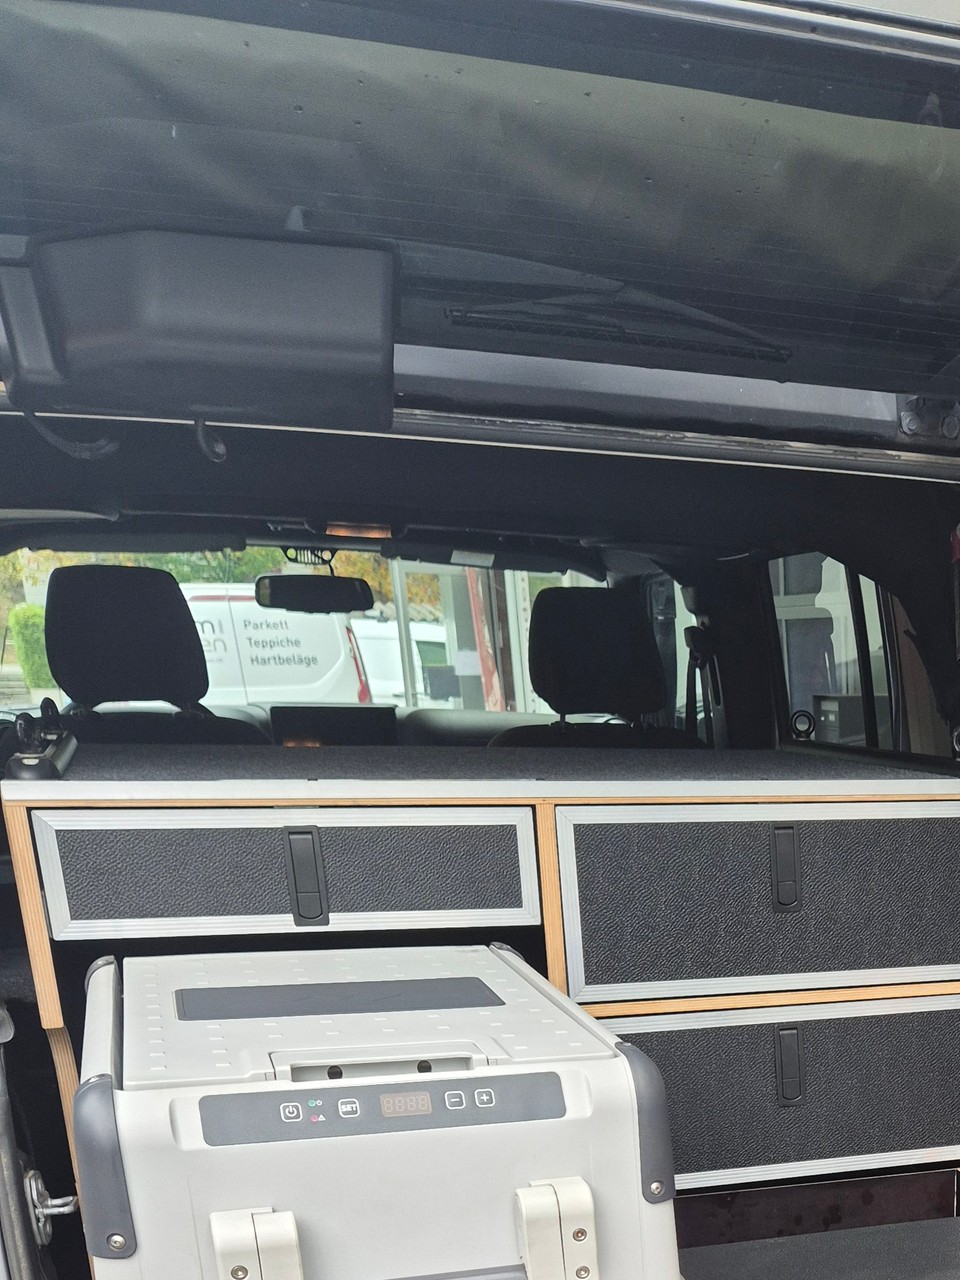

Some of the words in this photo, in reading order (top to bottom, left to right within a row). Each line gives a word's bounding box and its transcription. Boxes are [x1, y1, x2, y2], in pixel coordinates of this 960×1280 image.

[243, 619, 289, 631] Parkett
[246, 637, 301, 649] Teppiche
[250, 654, 319, 667] Hartbeläge
[340, 1104, 357, 1112] SET
